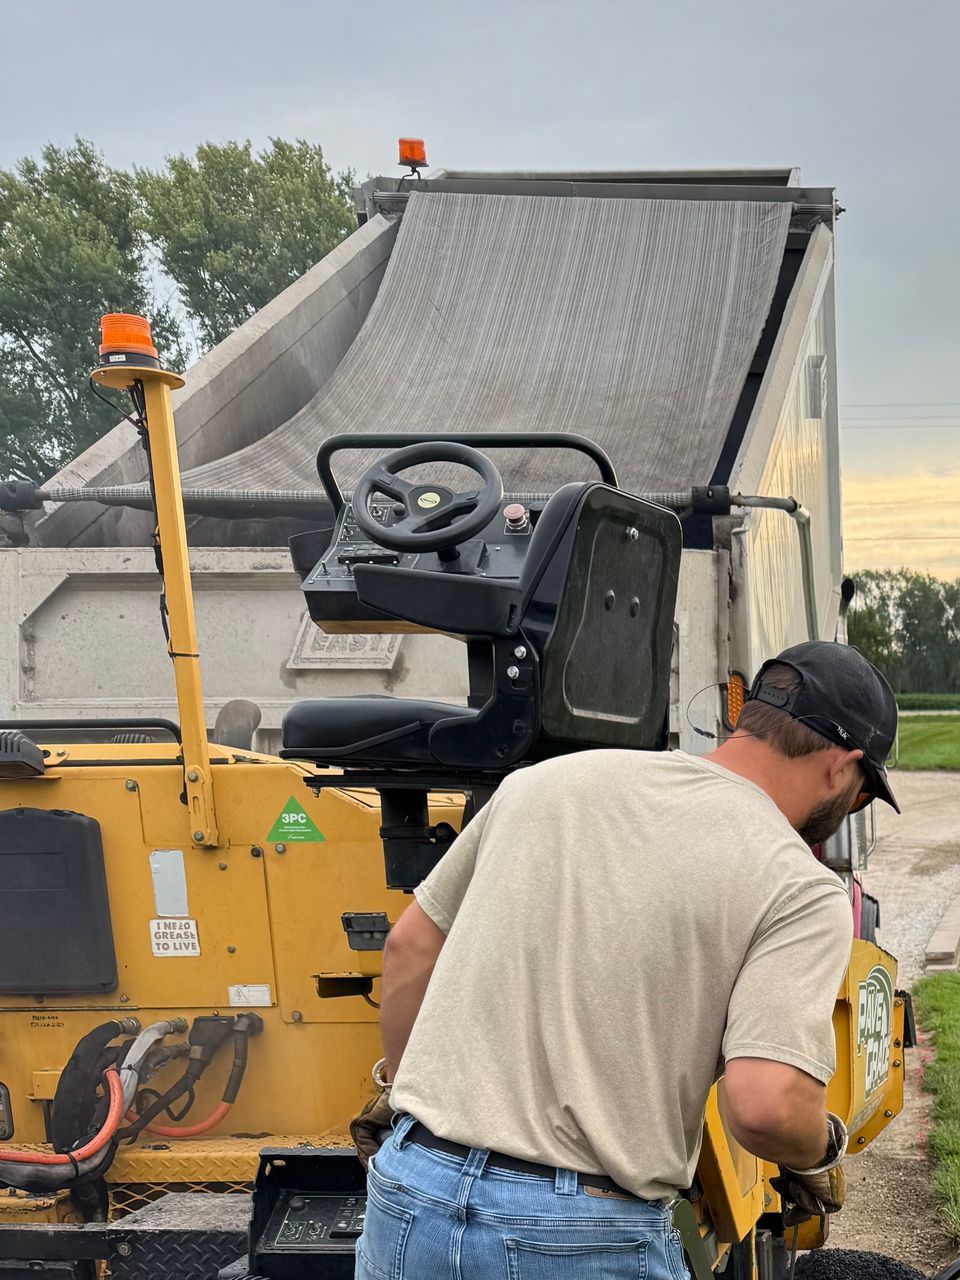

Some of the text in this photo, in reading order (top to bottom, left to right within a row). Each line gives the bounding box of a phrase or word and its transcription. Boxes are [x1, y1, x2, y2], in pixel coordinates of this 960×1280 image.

[281, 813, 307, 823] 3PC
[154, 931, 196, 940] GREASE
[155, 942, 197, 951] TO LIVE
